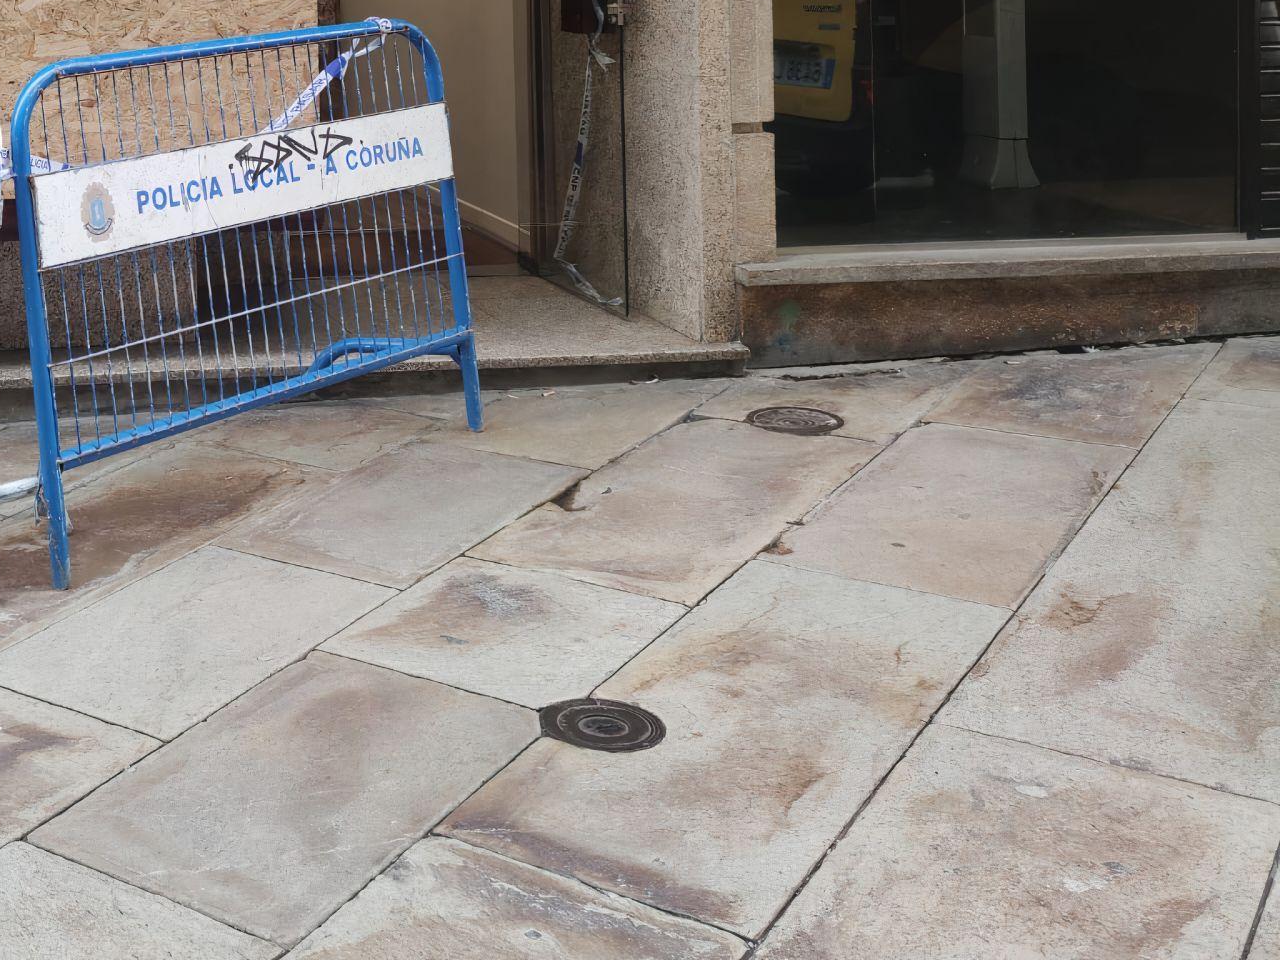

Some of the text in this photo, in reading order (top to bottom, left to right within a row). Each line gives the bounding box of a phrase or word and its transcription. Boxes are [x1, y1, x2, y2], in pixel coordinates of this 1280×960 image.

[137, 176, 223, 215] POLICIA
[231, 160, 301, 194] LOCAL
[345, 137, 424, 171] CORUÑA
